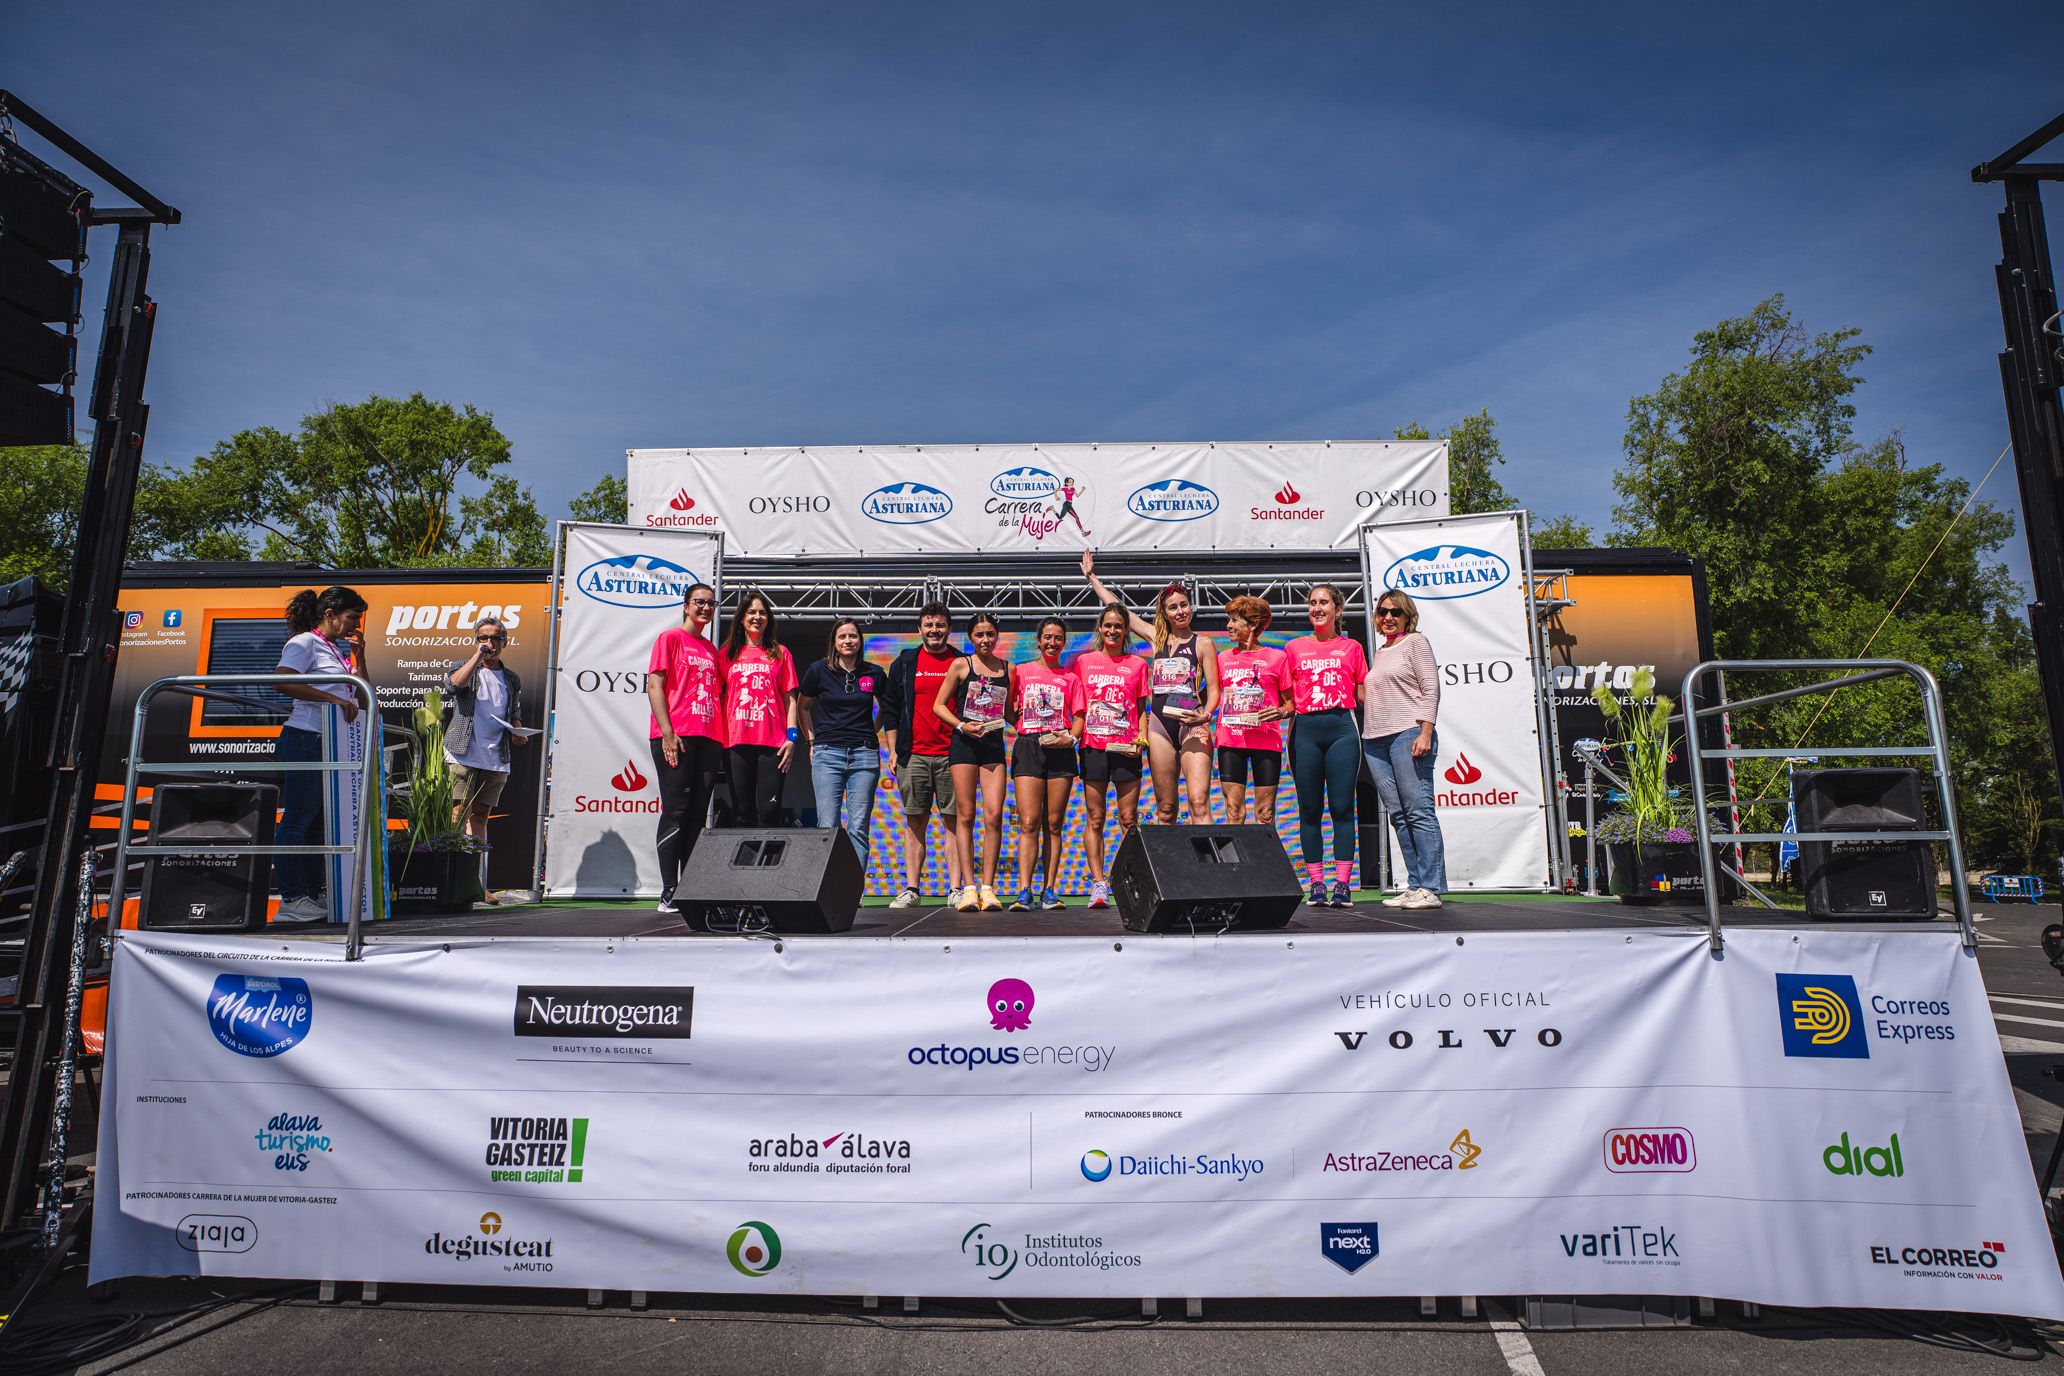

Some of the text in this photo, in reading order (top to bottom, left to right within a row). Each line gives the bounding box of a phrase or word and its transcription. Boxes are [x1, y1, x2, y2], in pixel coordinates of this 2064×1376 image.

[996, 479, 1055, 492] ASTURIANA
[749, 496, 831, 515] OYSHO
[869, 498, 947, 514] ASTURIANA
[984, 497, 1043, 514] Carrera
[1135, 495, 1213, 511] ASTURIANA
[1356, 489, 1437, 508] OYSHO
[646, 513, 720, 528] Santander
[1251, 507, 1325, 521] Santander
[998, 512, 1064, 540] de la Mujer
[1410, 559, 1496, 571] CENTRAL LECHERA
[606, 570, 646, 579] CENTRAL
[1393, 567, 1502, 589] ASTURIANA
[120, 638, 187, 646] onorizacionesPortos
[385, 637, 476, 647] SONORIZACIO
[397, 659, 428, 670] Rampa
[430, 659, 442, 668] de
[732, 662, 770, 675] CARRERA
[1301, 658, 1341, 671] CARRERA
[1437, 660, 1514, 686] SHO
[408, 672, 442, 681] Tarimas
[576, 670, 649, 694] OYS
[1088, 674, 1125, 686] CARRERA
[375, 686, 411, 697] Soporte
[412, 687, 432, 697] para
[735, 707, 765, 721] MUJER
[189, 739, 276, 754] www.sonorizacio
[575, 796, 663, 814] Santand
[1433, 788, 1519, 807] ntander
[399, 886, 438, 896] portos
[145, 948, 202, 958] PATROCINADORES
[216, 952, 249, 960] CIRCUITO
[1340, 990, 1551, 1010] VEHÍCULO OFICIAL
[1871, 995, 1951, 1016] Correos
[212, 991, 307, 1035] Marlene
[526, 996, 681, 1033] Neutrogena
[1334, 1028, 1563, 1051] VOLVO
[1876, 1019, 1956, 1044] Express
[219, 1031, 293, 1055] HIJA DE LOS ALPES
[552, 1045, 653, 1055] BEAUTY TO A SCIENCE
[908, 1043, 1116, 1072] octopus energy
[136, 1095, 188, 1104] INSTITUCIONES
[267, 1112, 323, 1132] alava
[1084, 1111, 1183, 1119] PATROCINADORES BRONCE
[490, 1117, 568, 1141] VITORIA
[749, 1133, 911, 1159] araba álava
[1611, 1133, 1688, 1166] COSMO
[1823, 1131, 1904, 1178] dial
[274, 1152, 311, 1172] eus
[485, 1143, 568, 1167] GASTEIZ
[1322, 1151, 1453, 1172] AstraZeneca
[491, 1168, 564, 1184] green capital
[748, 1162, 911, 1175] foru aldundia diputación foral
[1119, 1153, 1265, 1182] Daiichi-Sankyo
[126, 1191, 337, 1205] PATROCINADORES CARRERA DE LA MUJER DE VITORIA-GASTEIZ
[425, 1232, 554, 1262] degusteat
[1025, 1234, 1103, 1249] Institutos
[1329, 1236, 1372, 1249] next
[1560, 1226, 1679, 1257] variTek
[1025, 1251, 1141, 1271] Odontológicos
[1870, 1246, 1998, 1268] EL CORREO
[504, 1262, 553, 1272] by AMUTIO
[1903, 1270, 2004, 1282] INFORMACIÓN CON VALOR
